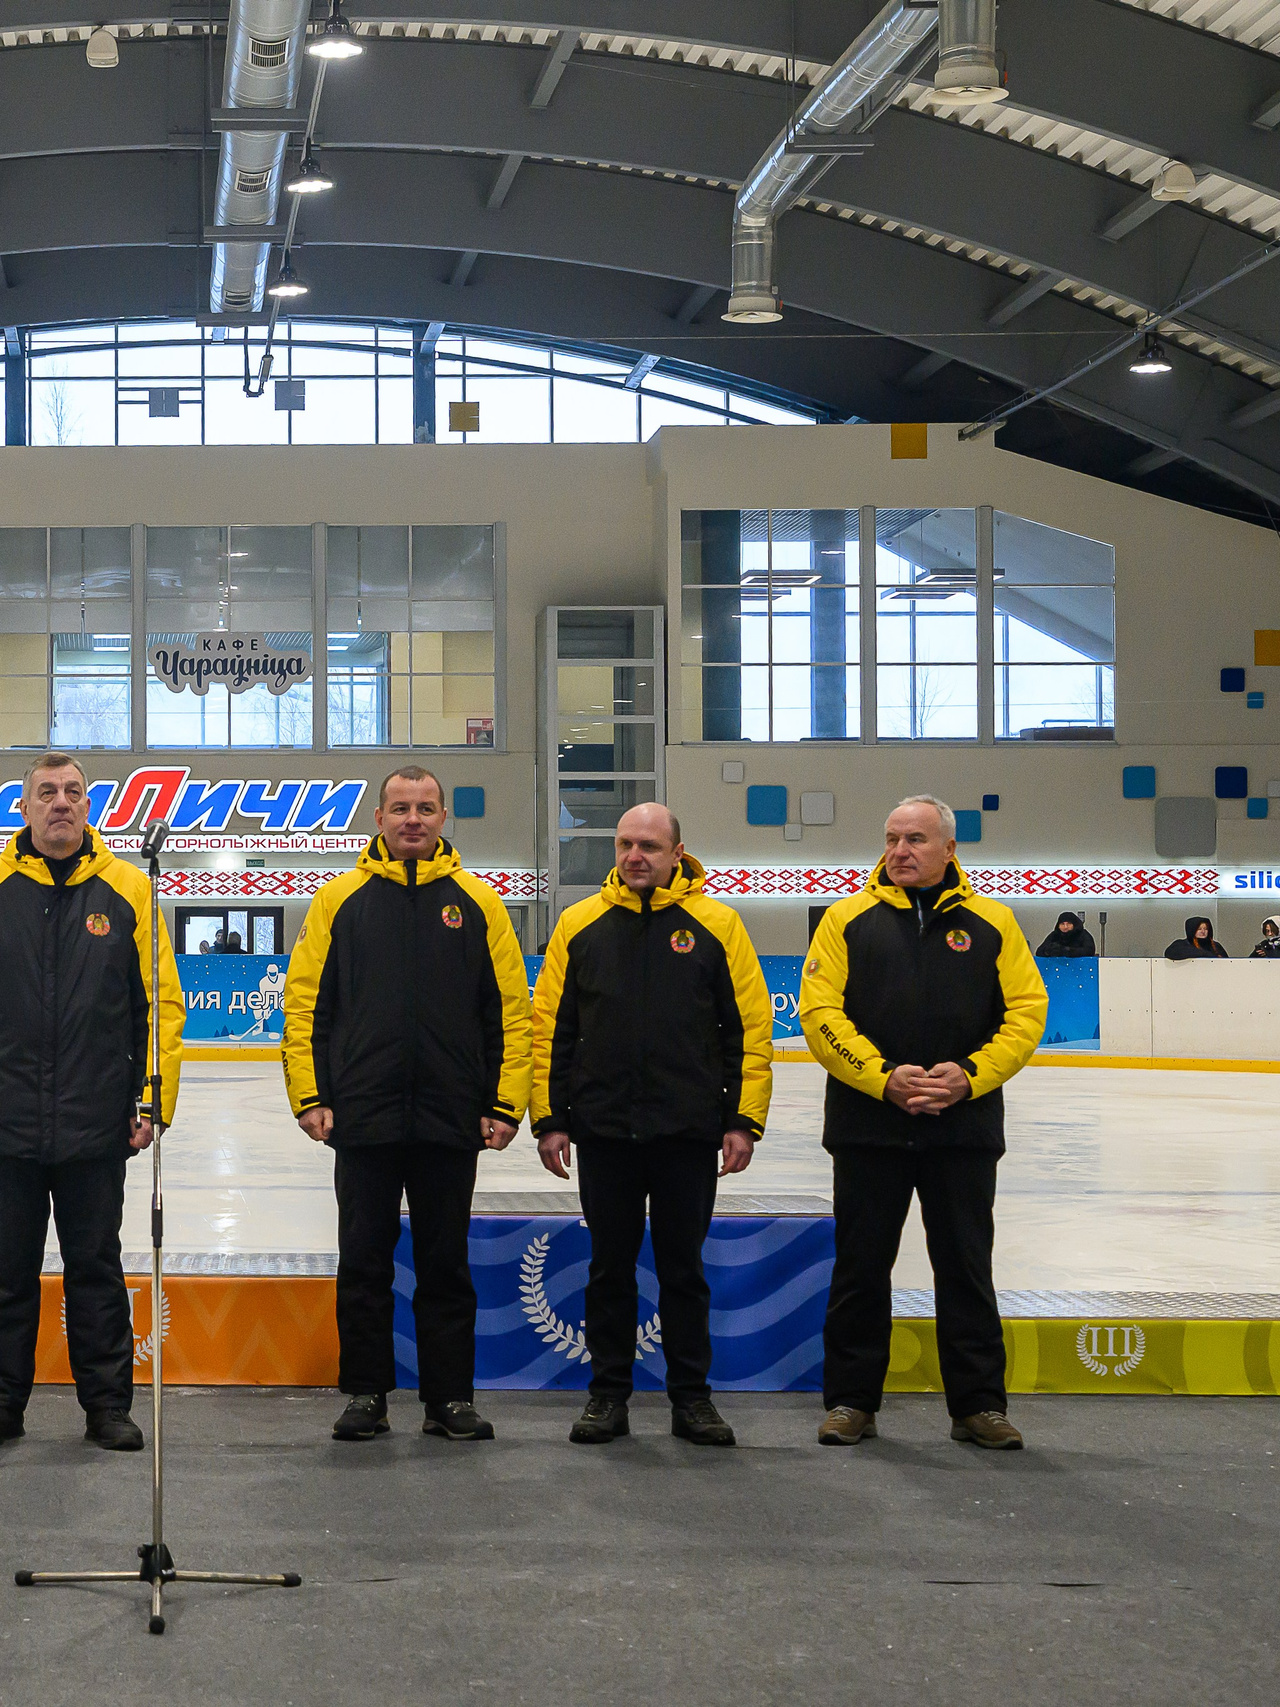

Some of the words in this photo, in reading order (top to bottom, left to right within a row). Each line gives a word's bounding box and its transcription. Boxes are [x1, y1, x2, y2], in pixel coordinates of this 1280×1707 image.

[203, 639, 258, 651] КАФЕ
[155, 650, 306, 688] Чараўніца
[166, 836, 308, 849] ГОРНОЛЫЖНЫЙ
[312, 838, 368, 850] ЦЕНТР
[819, 1023, 866, 1071] BELARUS
[1087, 1326, 1137, 1358] III
